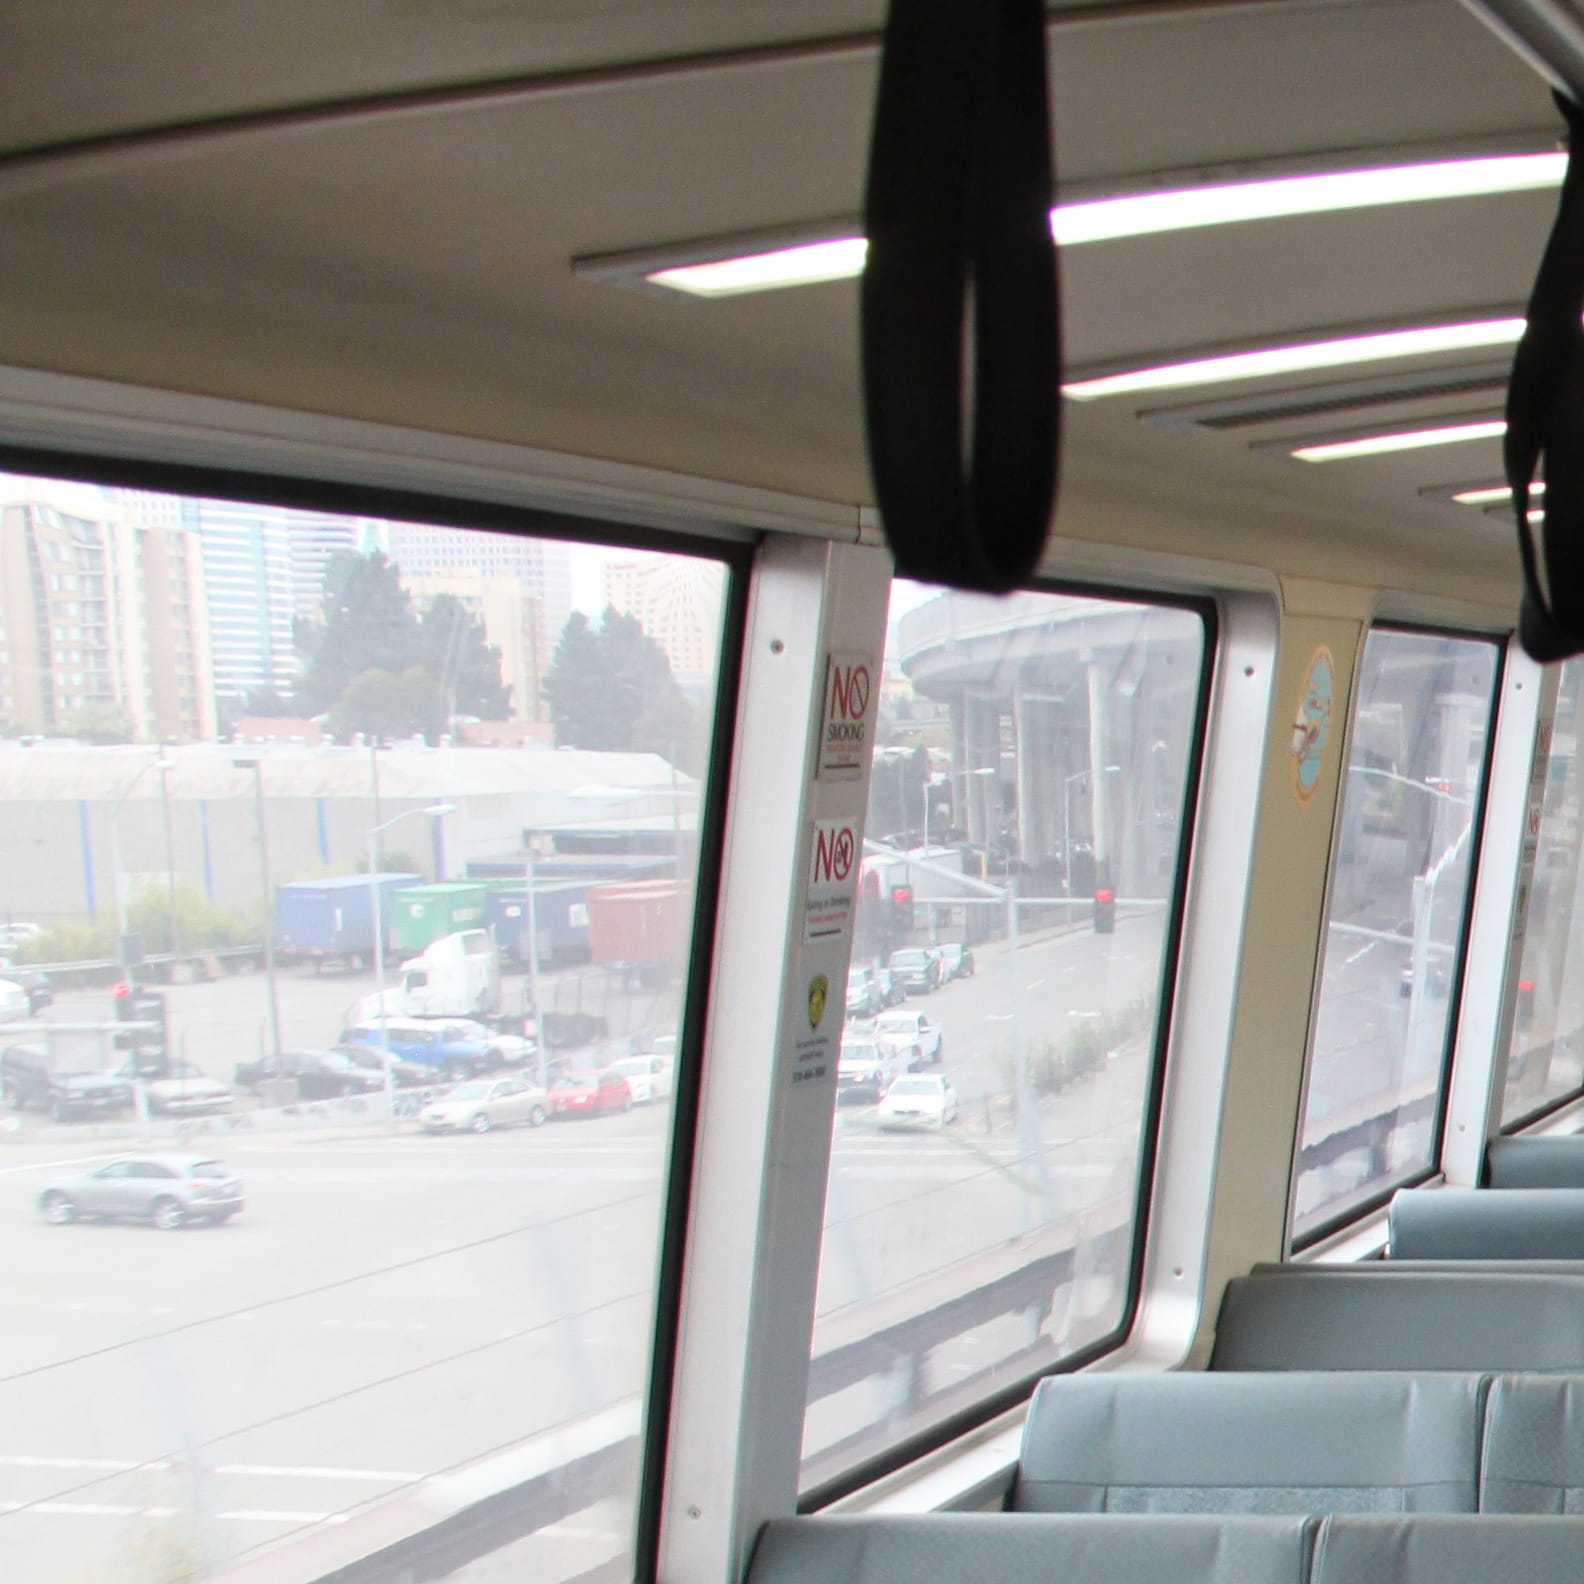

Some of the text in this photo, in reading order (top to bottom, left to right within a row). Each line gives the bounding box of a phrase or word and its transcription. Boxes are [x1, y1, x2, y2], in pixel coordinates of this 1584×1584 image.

[830, 665, 869, 720] NO
[827, 723, 864, 741] SMOKING
[814, 827, 854, 883] NO
